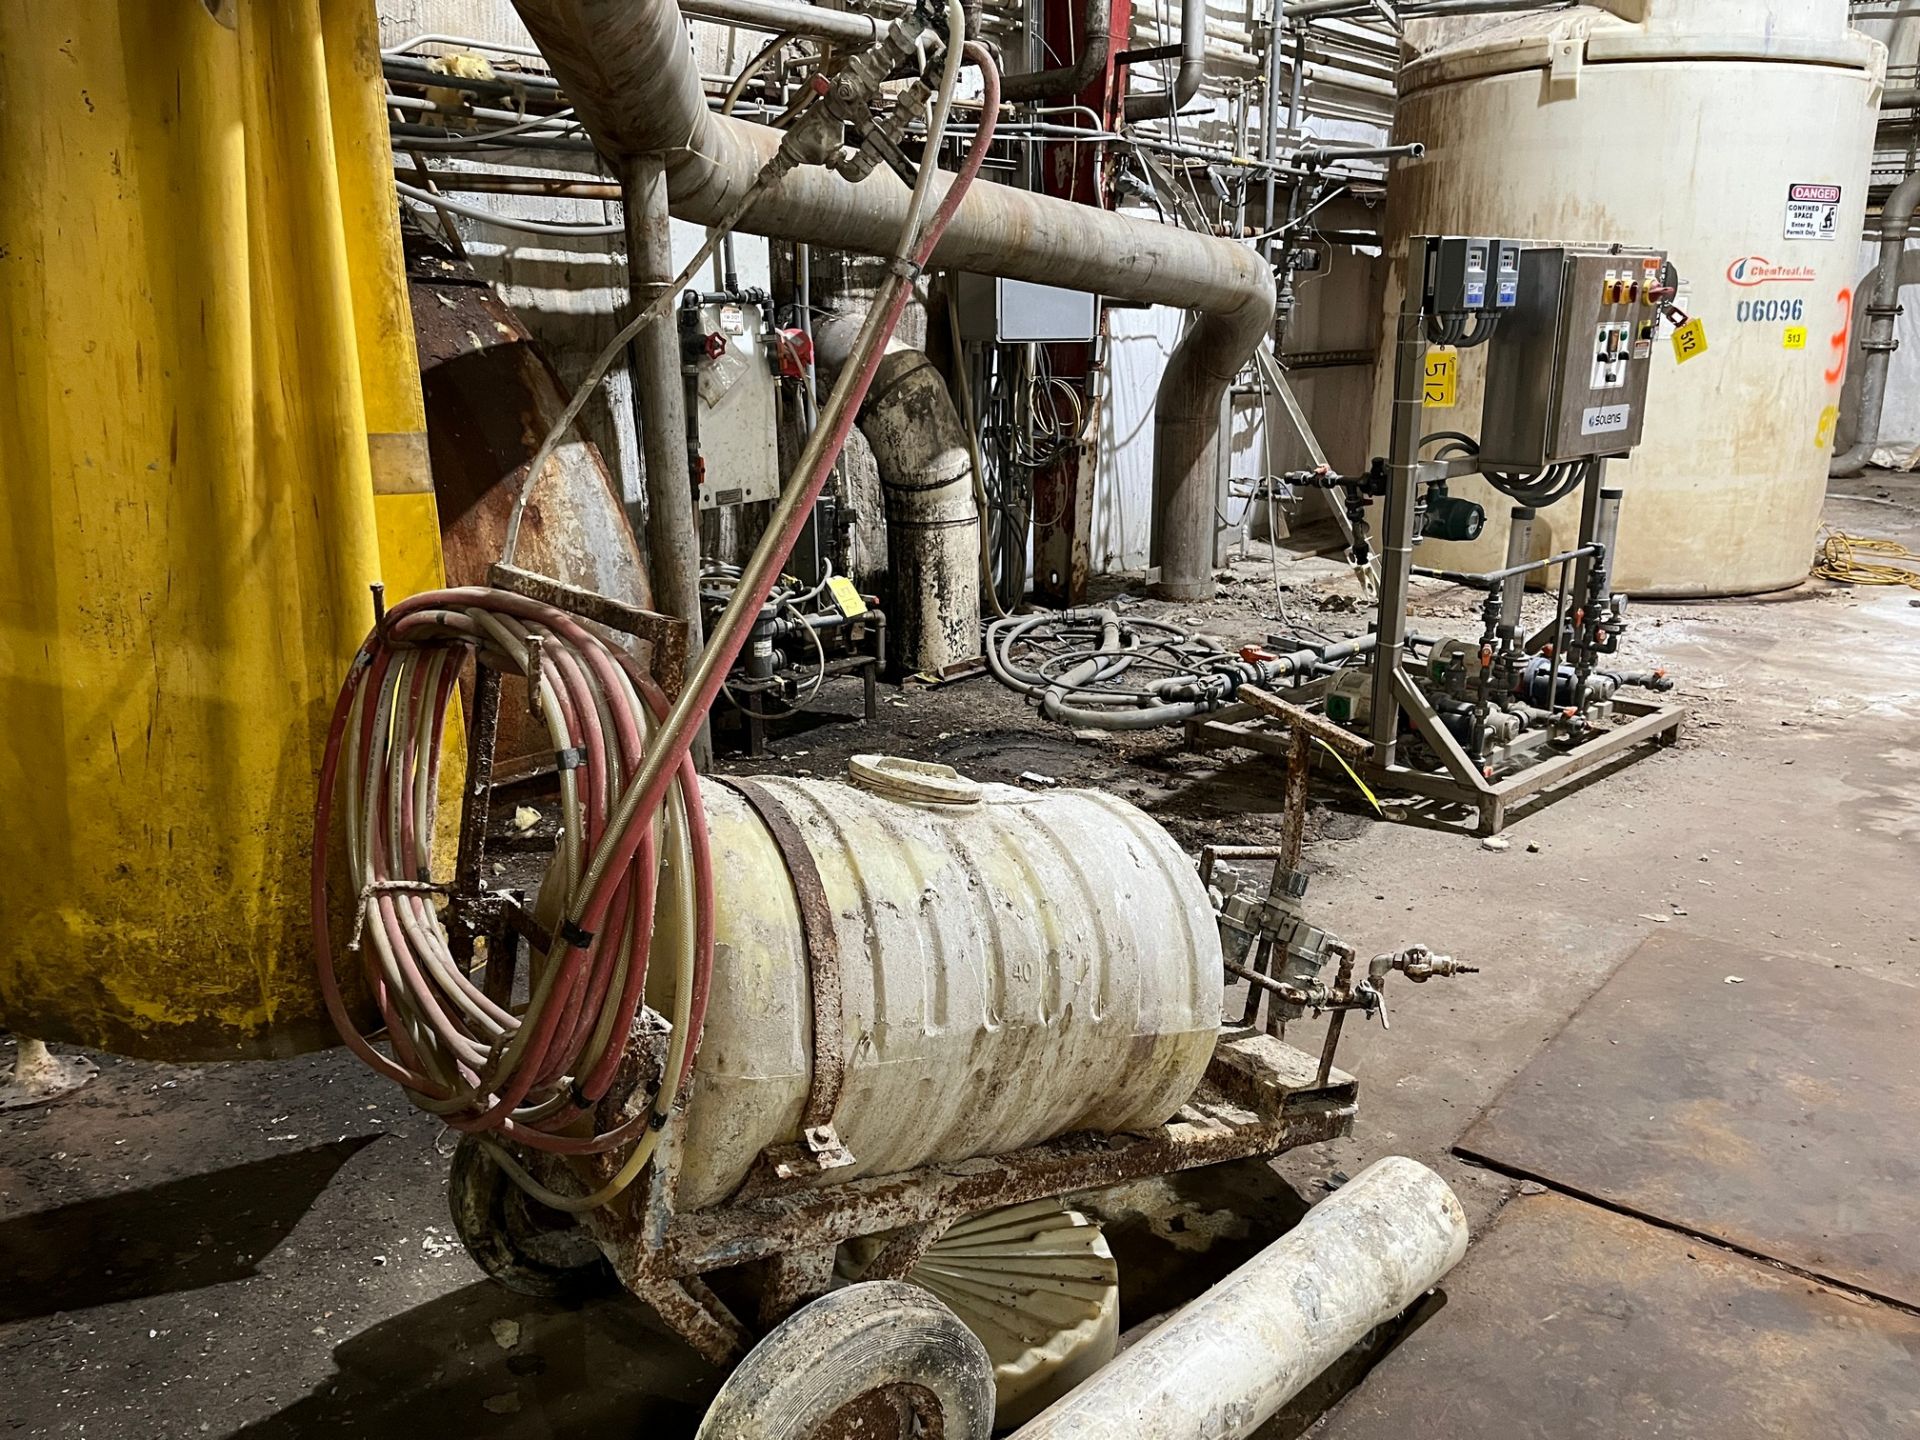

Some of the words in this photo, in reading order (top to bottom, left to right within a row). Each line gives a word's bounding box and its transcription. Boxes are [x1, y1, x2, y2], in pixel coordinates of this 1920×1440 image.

[1795, 187, 1837, 199] DANGER
[1788, 204, 1820, 212] CONFINED
[1805, 229, 1816, 237] Only
[1737, 298, 1803, 322] 06096
[1680, 330, 1696, 353] 512
[1787, 333, 1801, 343] 513
[1424, 363, 1447, 403] 512
[1012, 962, 1032, 983] 40
